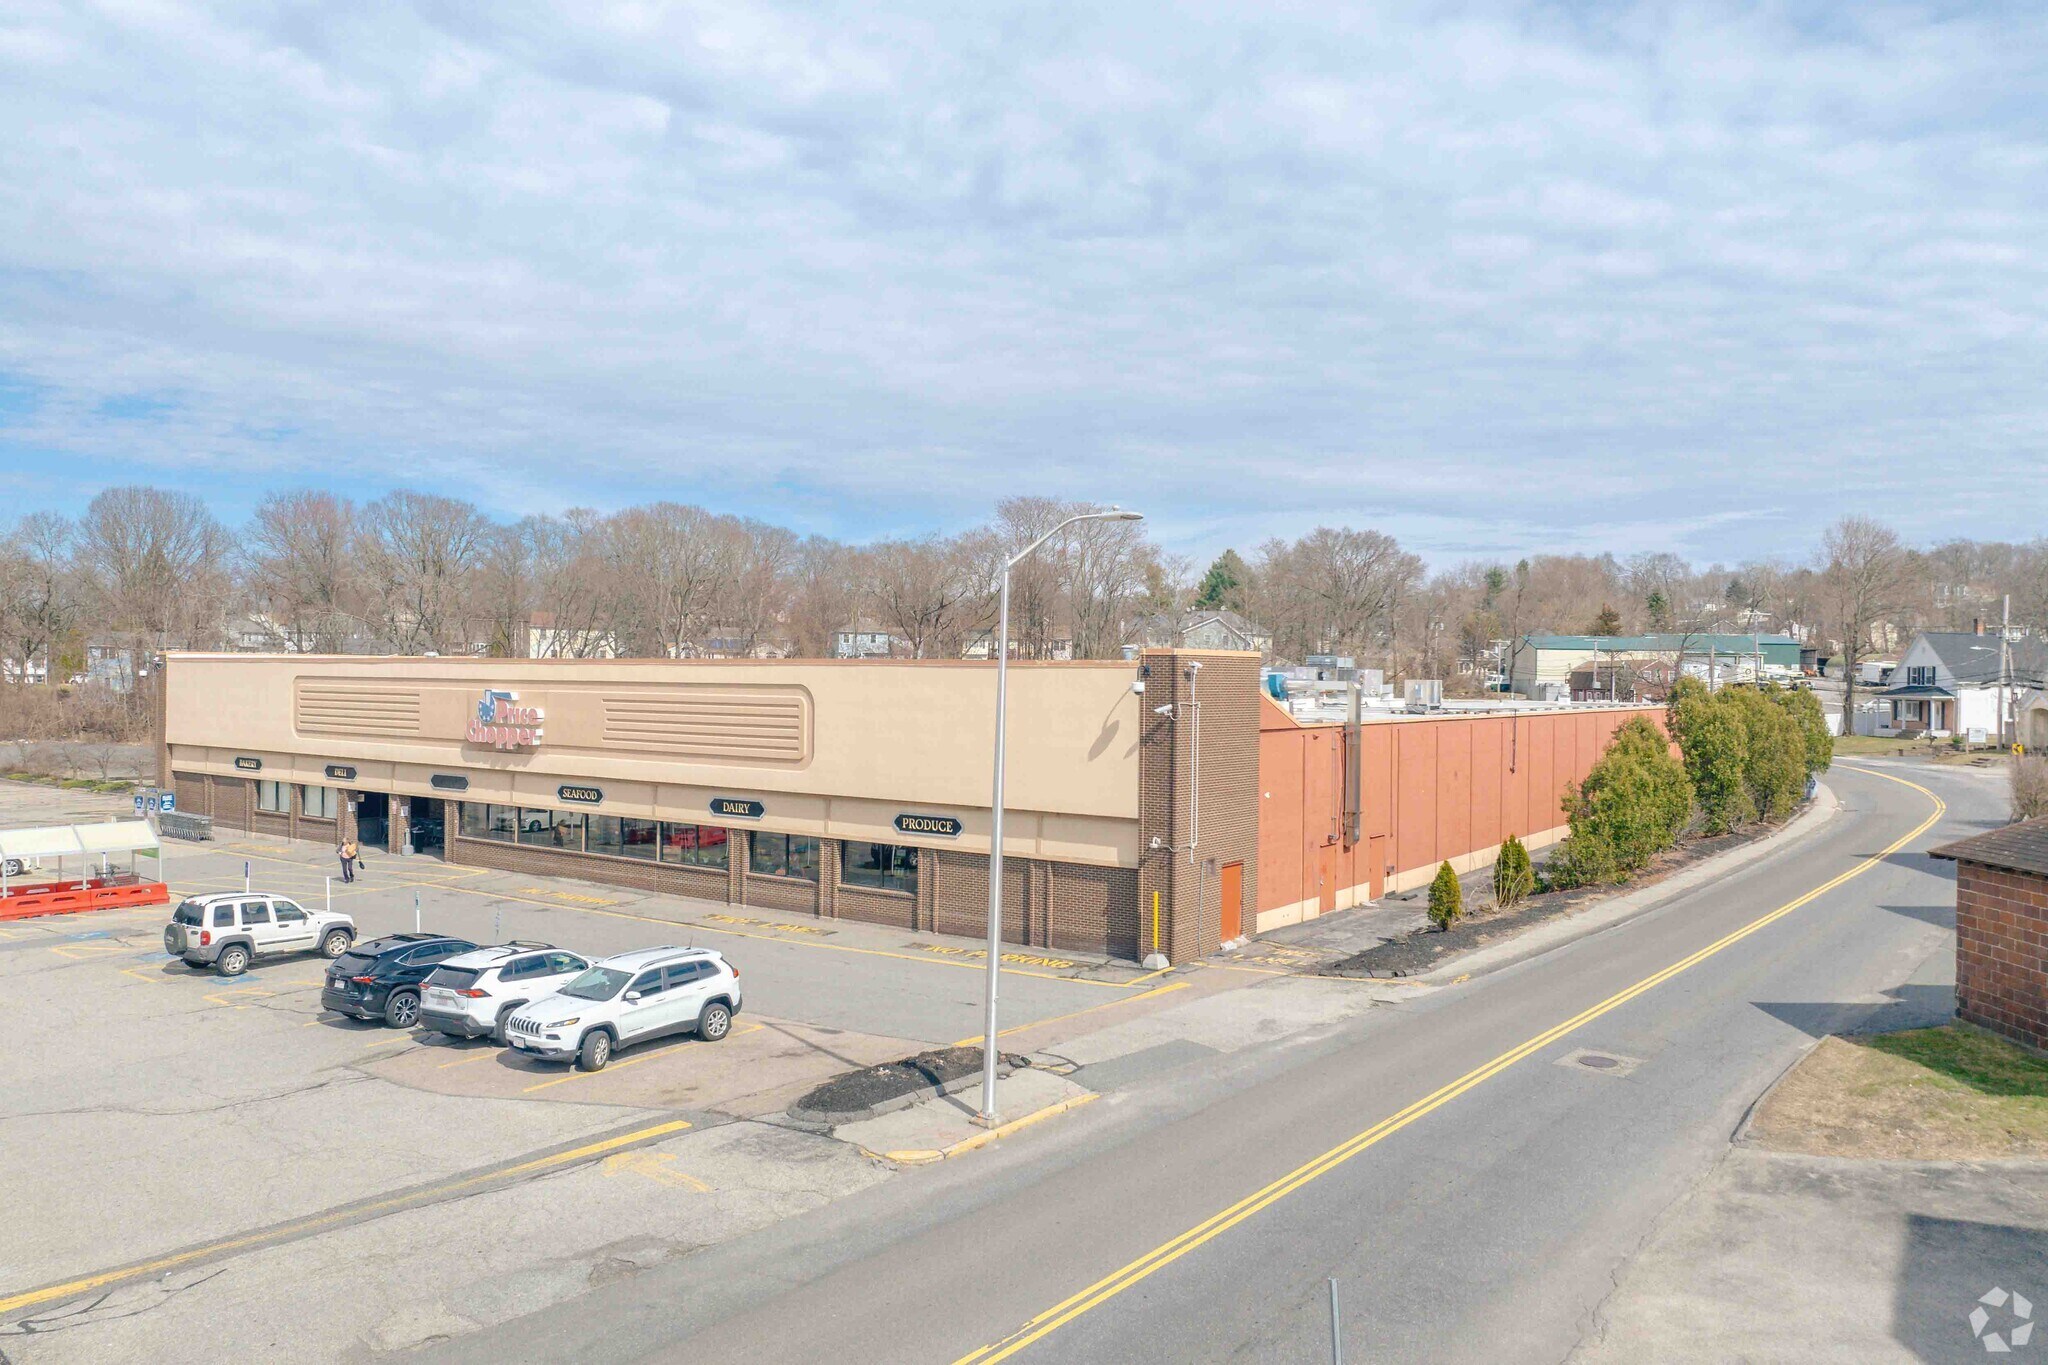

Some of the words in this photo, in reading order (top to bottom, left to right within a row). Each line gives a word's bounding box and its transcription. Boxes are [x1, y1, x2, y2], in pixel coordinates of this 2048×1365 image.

[495, 699, 541, 725] Price
[466, 719, 539, 750] Chopper
[334, 768, 347, 777] DELI
[562, 788, 598, 800] SEAFOOD
[722, 801, 751, 814] DAIRY
[901, 817, 954, 833] PRODUCE
[964, 949, 1075, 969] PRKING
